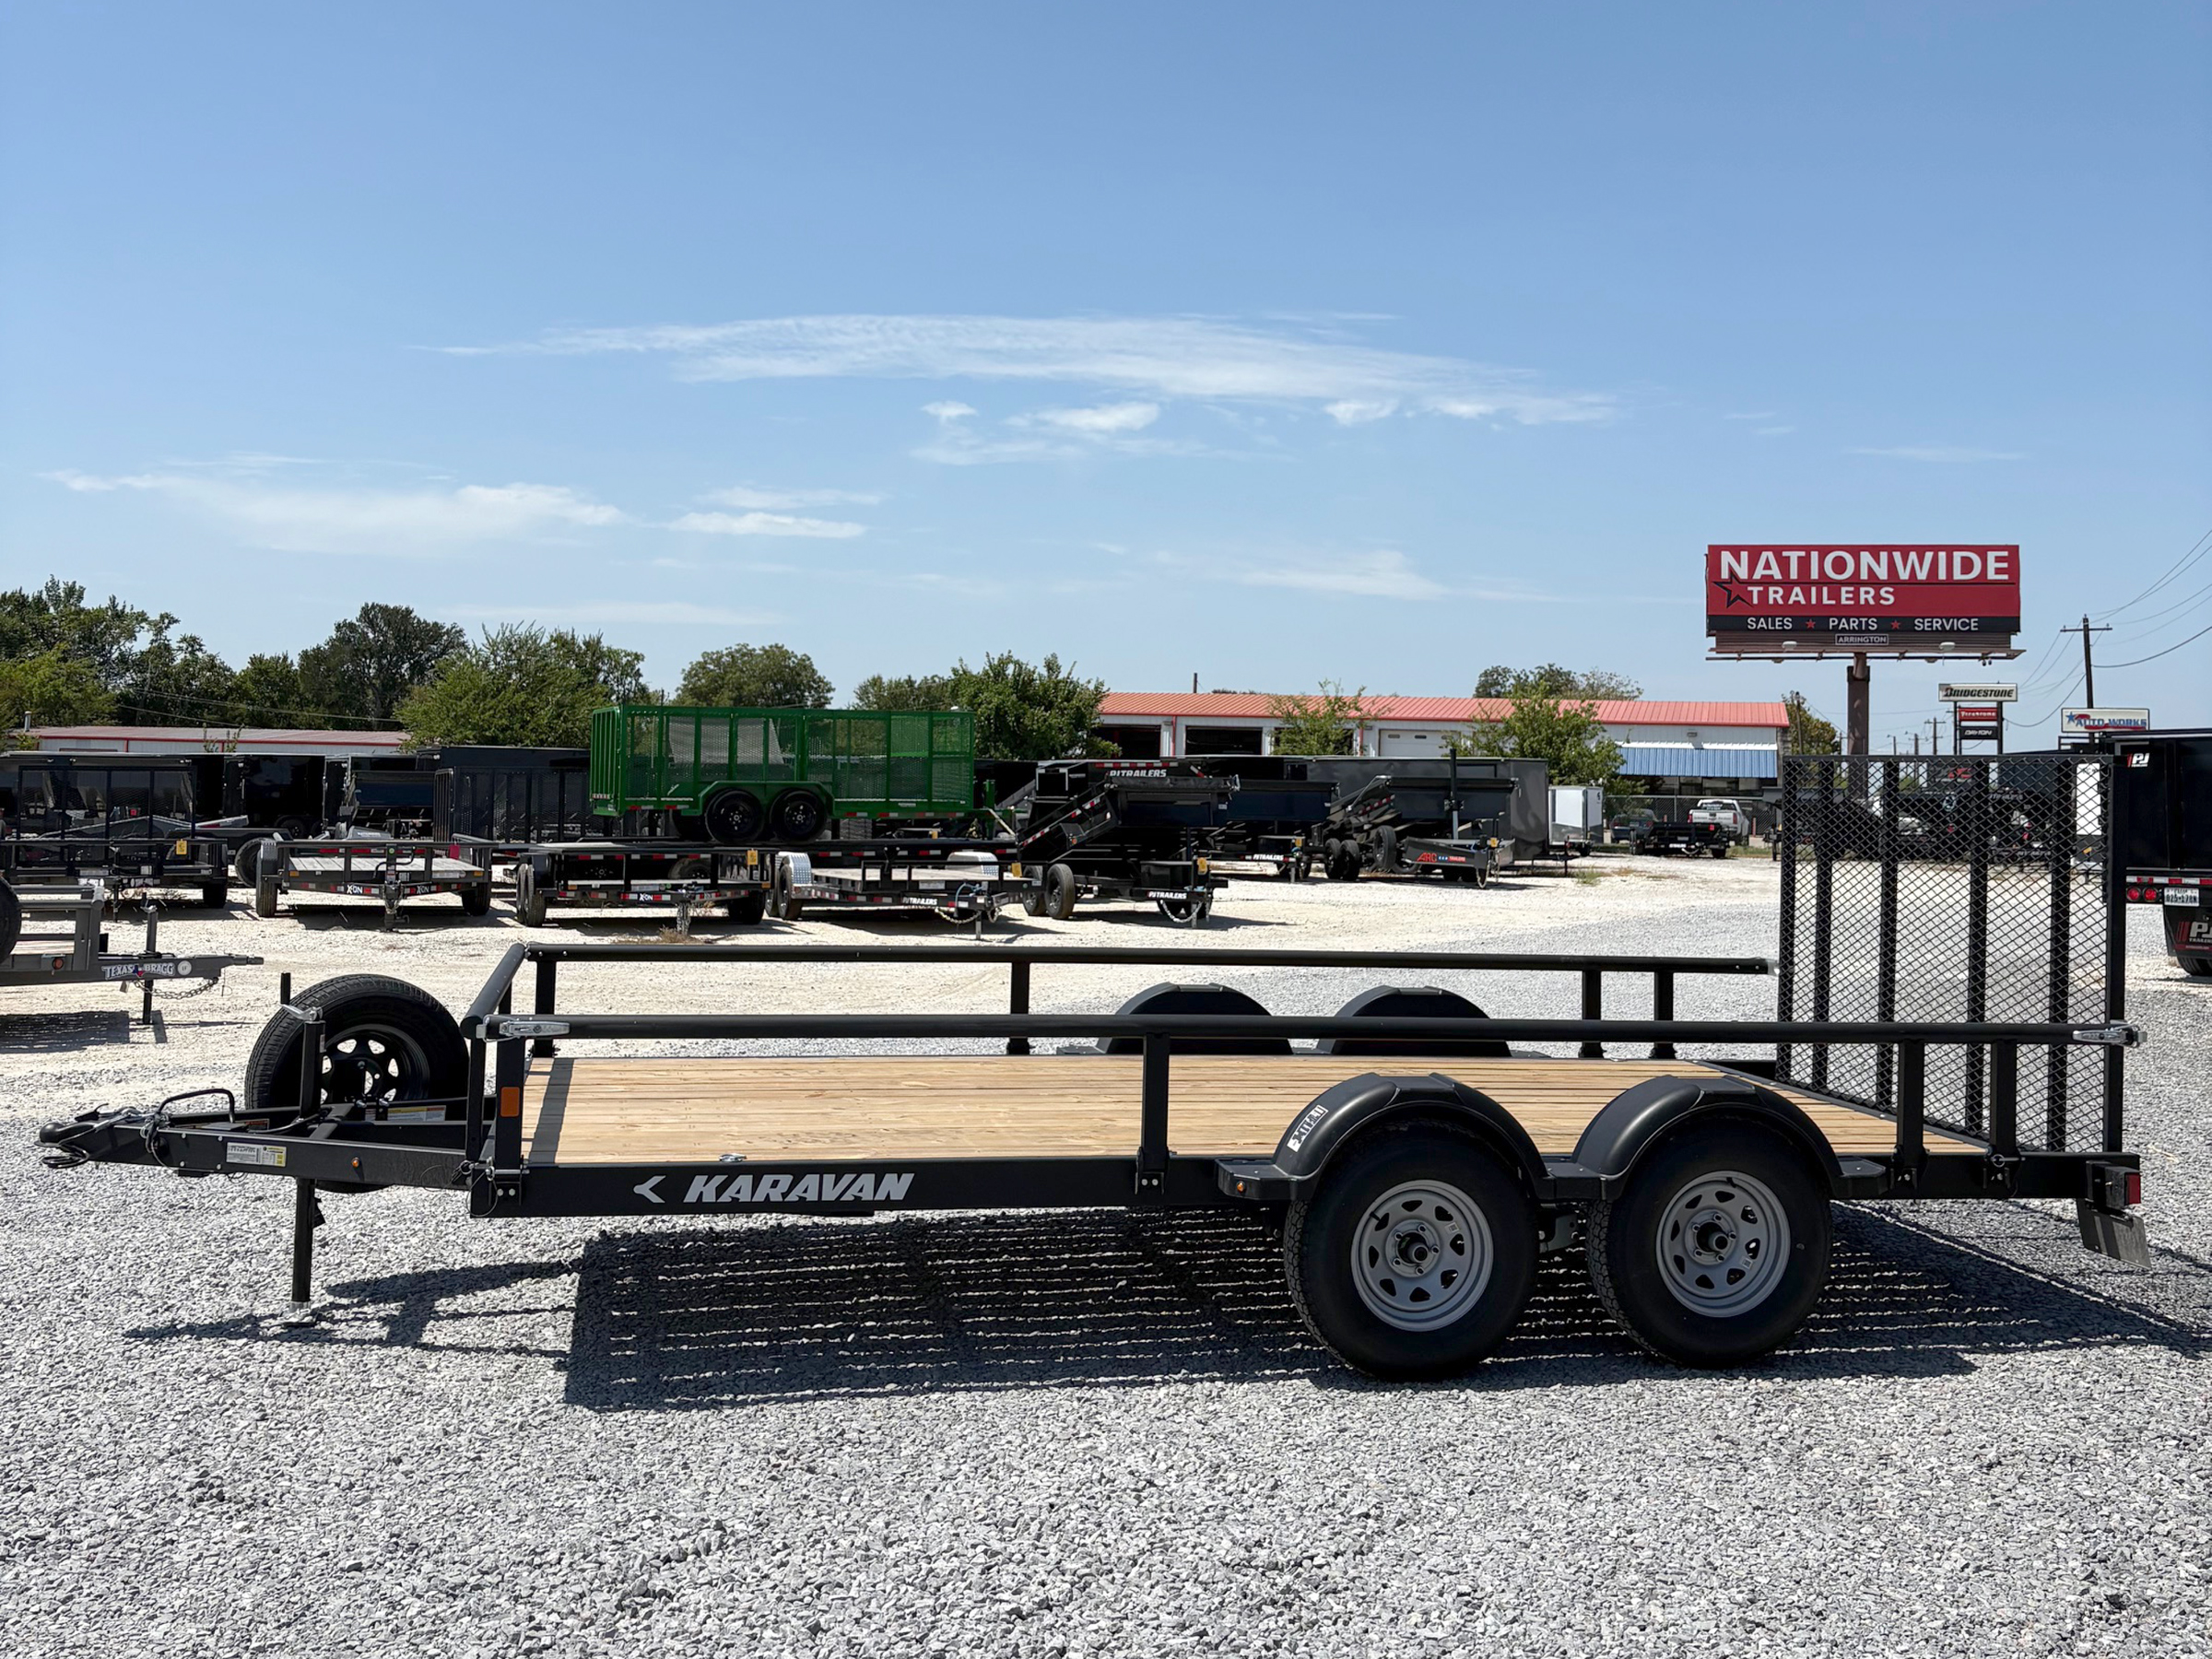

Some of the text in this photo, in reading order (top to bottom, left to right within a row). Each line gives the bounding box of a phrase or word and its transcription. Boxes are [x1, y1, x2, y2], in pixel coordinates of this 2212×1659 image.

[1720, 550, 2009, 580] NATIONWIDE
[1747, 586, 1896, 606] TRAILERS
[1747, 617, 1979, 630] SALES PARTS SERVICE
[1837, 635, 1888, 643] ARRINGTON
[1944, 687, 2015, 698] BRIDGESTONE
[2075, 718, 2147, 727] AUTO WORKS
[2131, 752, 2150, 765] PJ
[101, 964, 135, 980] TEXAS
[683, 1172, 915, 1204] KARAVAN
